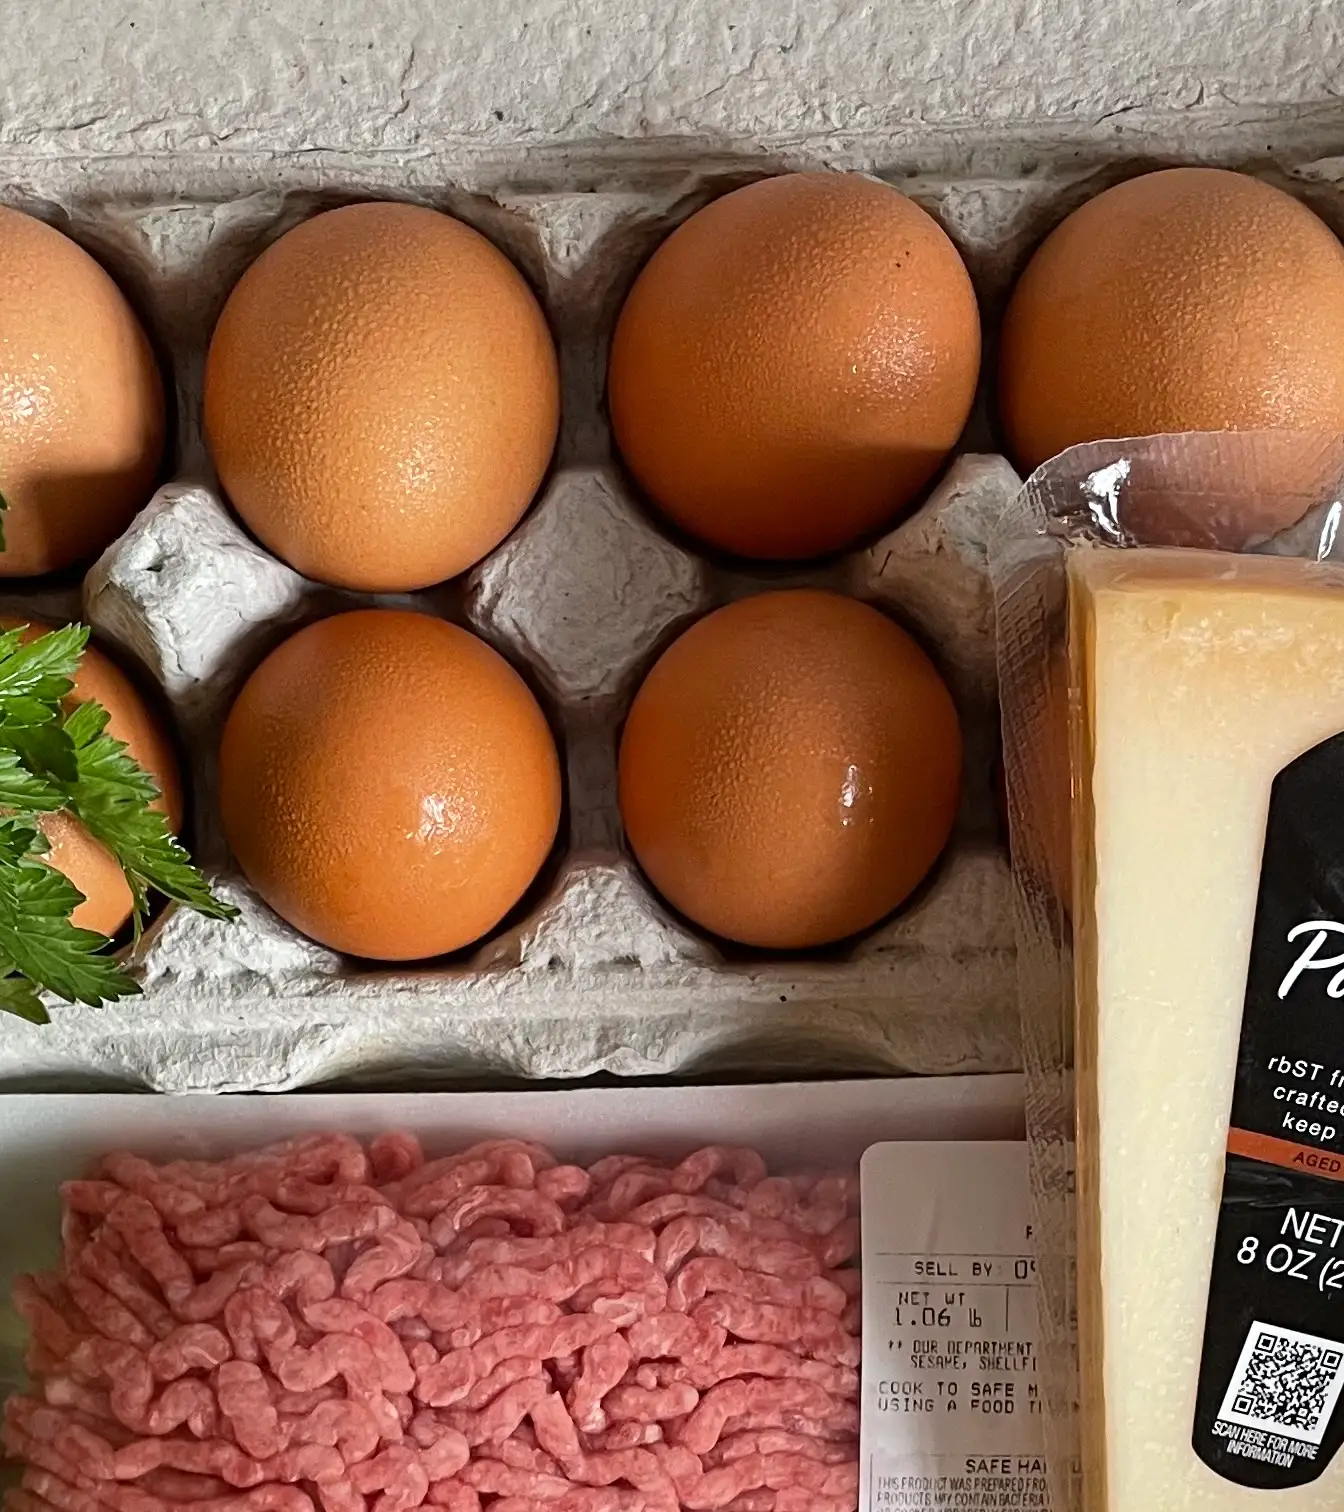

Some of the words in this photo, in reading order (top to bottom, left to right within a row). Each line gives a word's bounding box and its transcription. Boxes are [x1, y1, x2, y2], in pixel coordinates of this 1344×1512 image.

[1267, 1054, 1324, 1082] rbST
[1281, 1111, 1337, 1142] keep
[1292, 1151, 1342, 1174] AGED
[913, 1260, 959, 1277] SELL
[1236, 1235, 1260, 1266] 8
[1265, 1242, 1318, 1281] OZ
[895, 1307, 951, 1328] 1.06
[878, 1380, 924, 1395] COOK
[970, 1381, 1015, 1398] SAFE
[877, 1399, 935, 1414] USING
[970, 1399, 1015, 1415] FOOD
[1211, 1420, 1242, 1440] SCAN
[1240, 1427, 1269, 1447] HERE
[1266, 1434, 1289, 1453] FOR
[1287, 1440, 1320, 1461] MORE
[1226, 1439, 1295, 1469] INFORMATION
[965, 1458, 1012, 1475] SAFE
